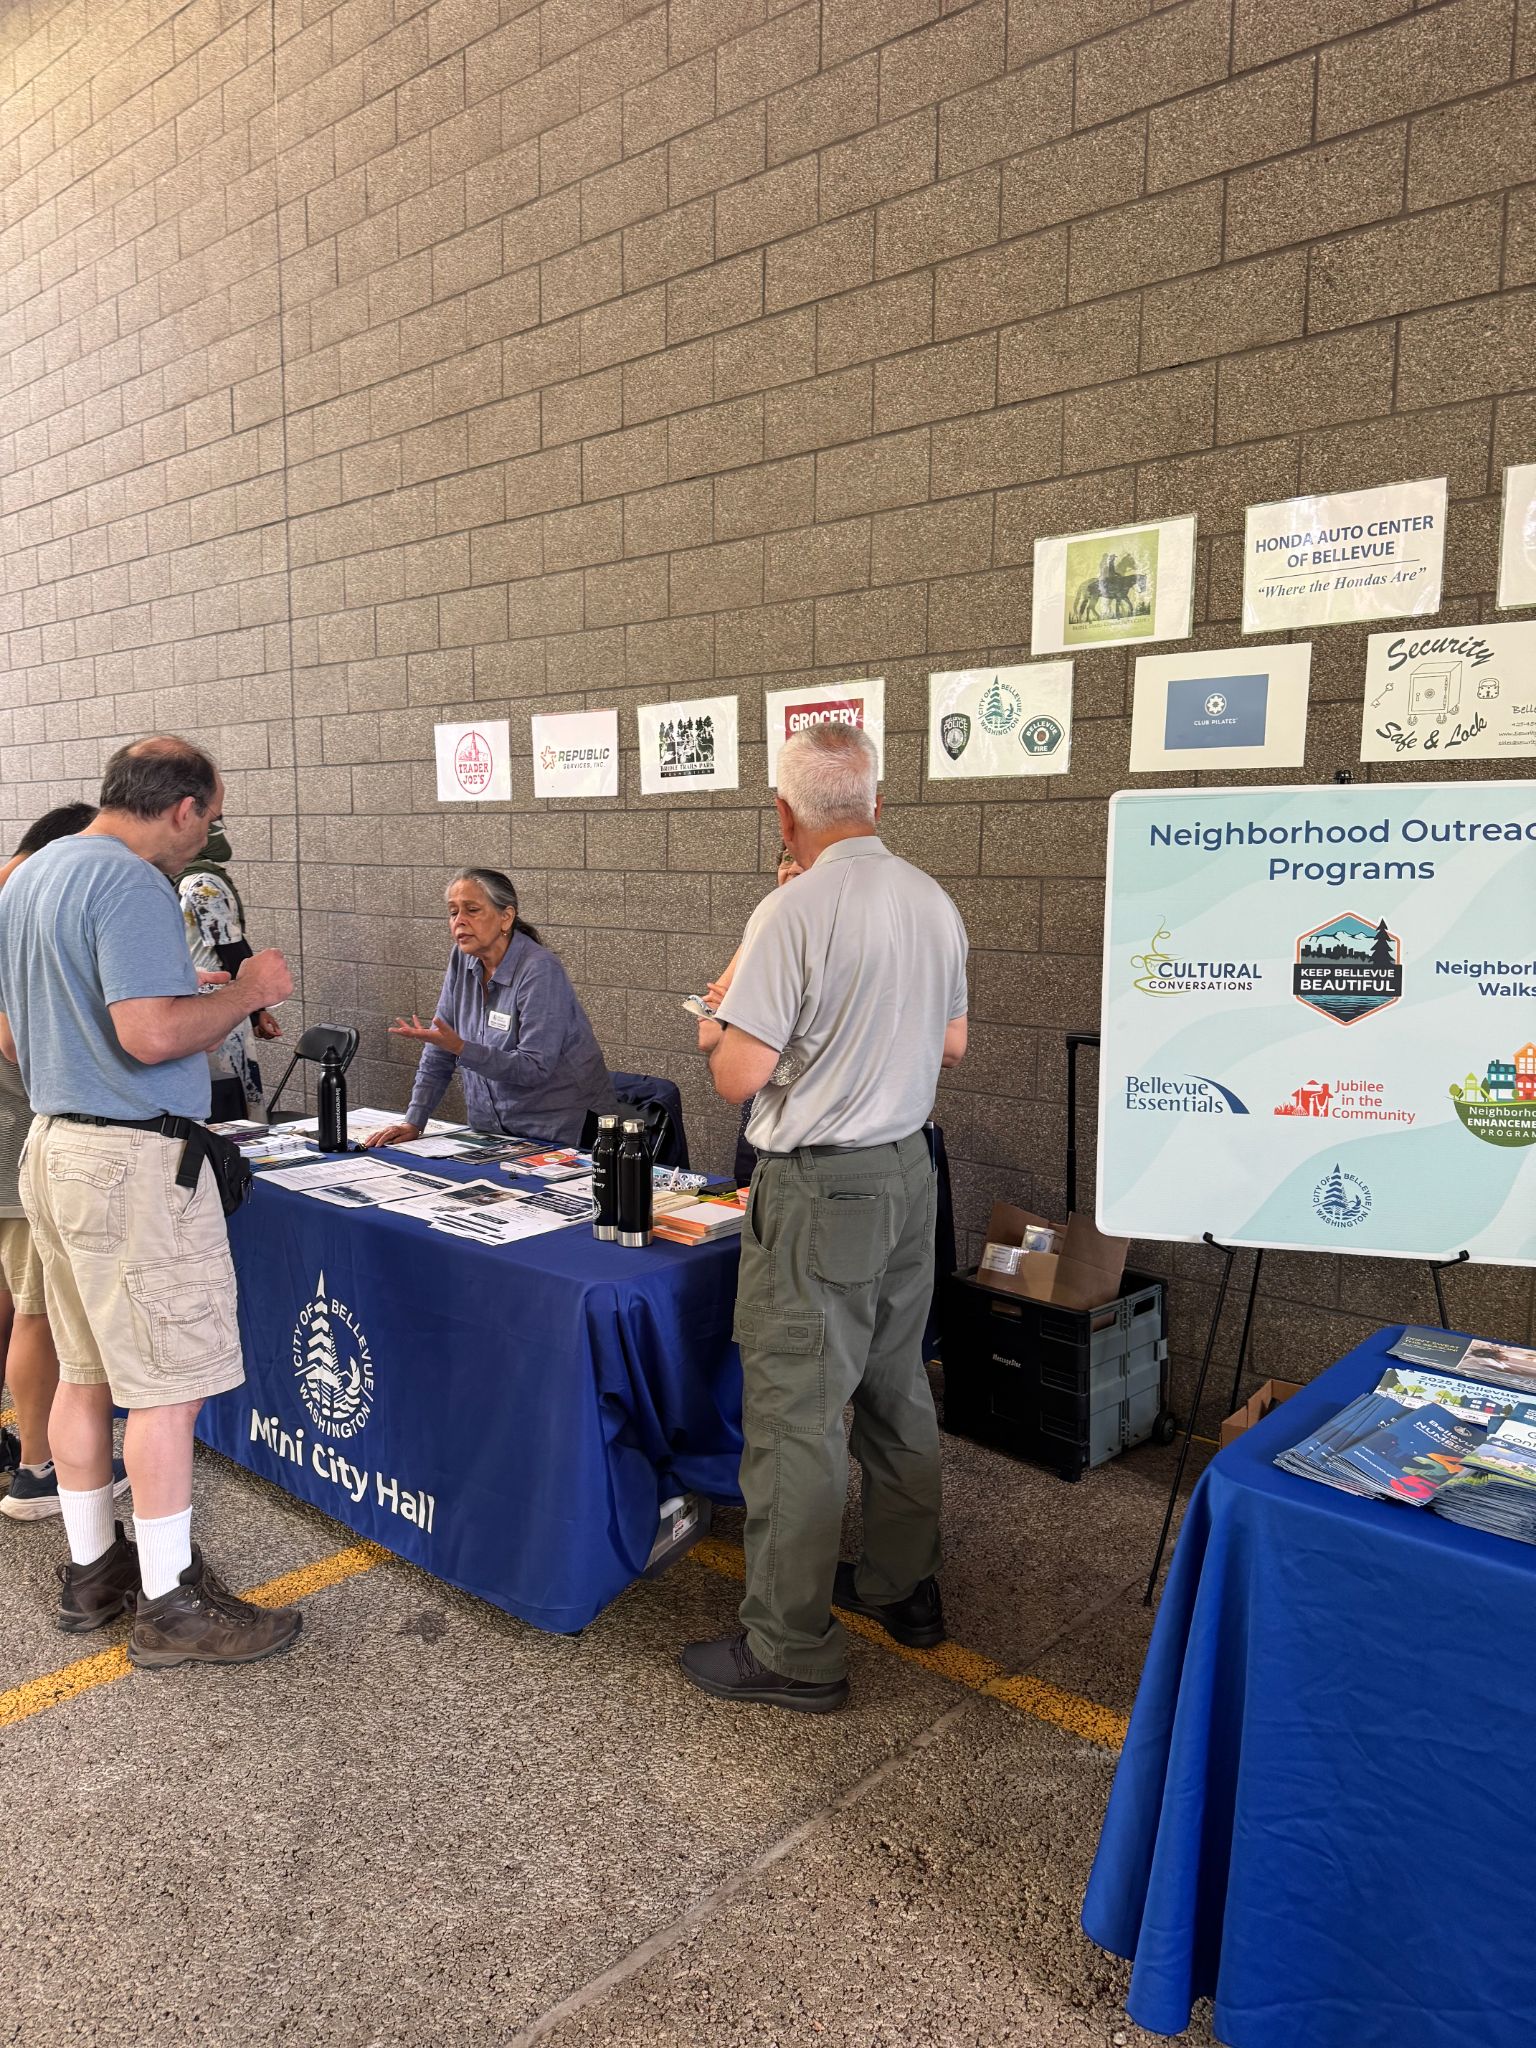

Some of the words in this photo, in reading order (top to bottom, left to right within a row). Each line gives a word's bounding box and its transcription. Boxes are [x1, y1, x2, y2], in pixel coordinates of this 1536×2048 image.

[1255, 532, 1314, 554] HONDA
[1317, 525, 1364, 544] AUTO
[1367, 515, 1434, 537] CENTER
[1287, 553, 1308, 568] OF
[1312, 541, 1395, 565] BELLEVUE
[1309, 579, 1330, 593] the
[1334, 572, 1388, 590] Hondas
[1387, 636, 1495, 671] Security
[984, 688, 992, 698] OF
[1001, 684, 1022, 713] BELLEVUE
[789, 708, 860, 732] GROCERY
[944, 721, 968, 732] POLICE
[980, 718, 1019, 736] WASHINGTON
[1026, 721, 1058, 737] BELLEVUE
[1375, 721, 1418, 752] Safe
[1424, 729, 1440, 750] &
[1444, 711, 1488, 749] Lock
[558, 748, 610, 761] REPUBLIC
[459, 763, 488, 773] TRADER
[463, 775, 484, 784] JOE'S
[1150, 819, 1390, 851] Neighborhood
[1401, 819, 1536, 843] Outreac
[1269, 857, 1435, 886] Programs
[1158, 962, 1262, 979] CULTURAL
[1301, 968, 1331, 977] KEEP
[1334, 969, 1395, 978] BELLEVUE
[1435, 959, 1536, 978] Neighbor
[1148, 981, 1253, 991] CONVERSATIONS
[1300, 979, 1395, 992] BEAUTIFUL
[1125, 1076, 1208, 1095] Bellevue
[1335, 1080, 1384, 1093] Jubilee
[1125, 1093, 1223, 1113] Essentials
[1342, 1094, 1354, 1105] in
[1359, 1095, 1382, 1106] the
[1332, 1107, 1416, 1124] Community
[1467, 1118, 1536, 1128] ENHANCEME
[1313, 1185, 1322, 1203] CITY
[1321, 1176, 1331, 1186] OF
[1344, 1173, 1372, 1206] BELLEVUE
[1316, 1209, 1368, 1228] WASHINGTON
[292, 1326, 303, 1368] CITY
[299, 1302, 314, 1325] OF
[331, 1299, 374, 1390] BELLEVUE
[1417, 1380, 1447, 1389] Tree
[1451, 1386, 1520, 1404] Giveaway
[1420, 1375, 1453, 1386] 2025
[1457, 1382, 1520, 1400] Bellevue
[299, 1382, 371, 1439] WASHINGTON
[250, 1408, 305, 1467] Mini
[312, 1443, 368, 1502] City
[376, 1471, 435, 1534] Hall
